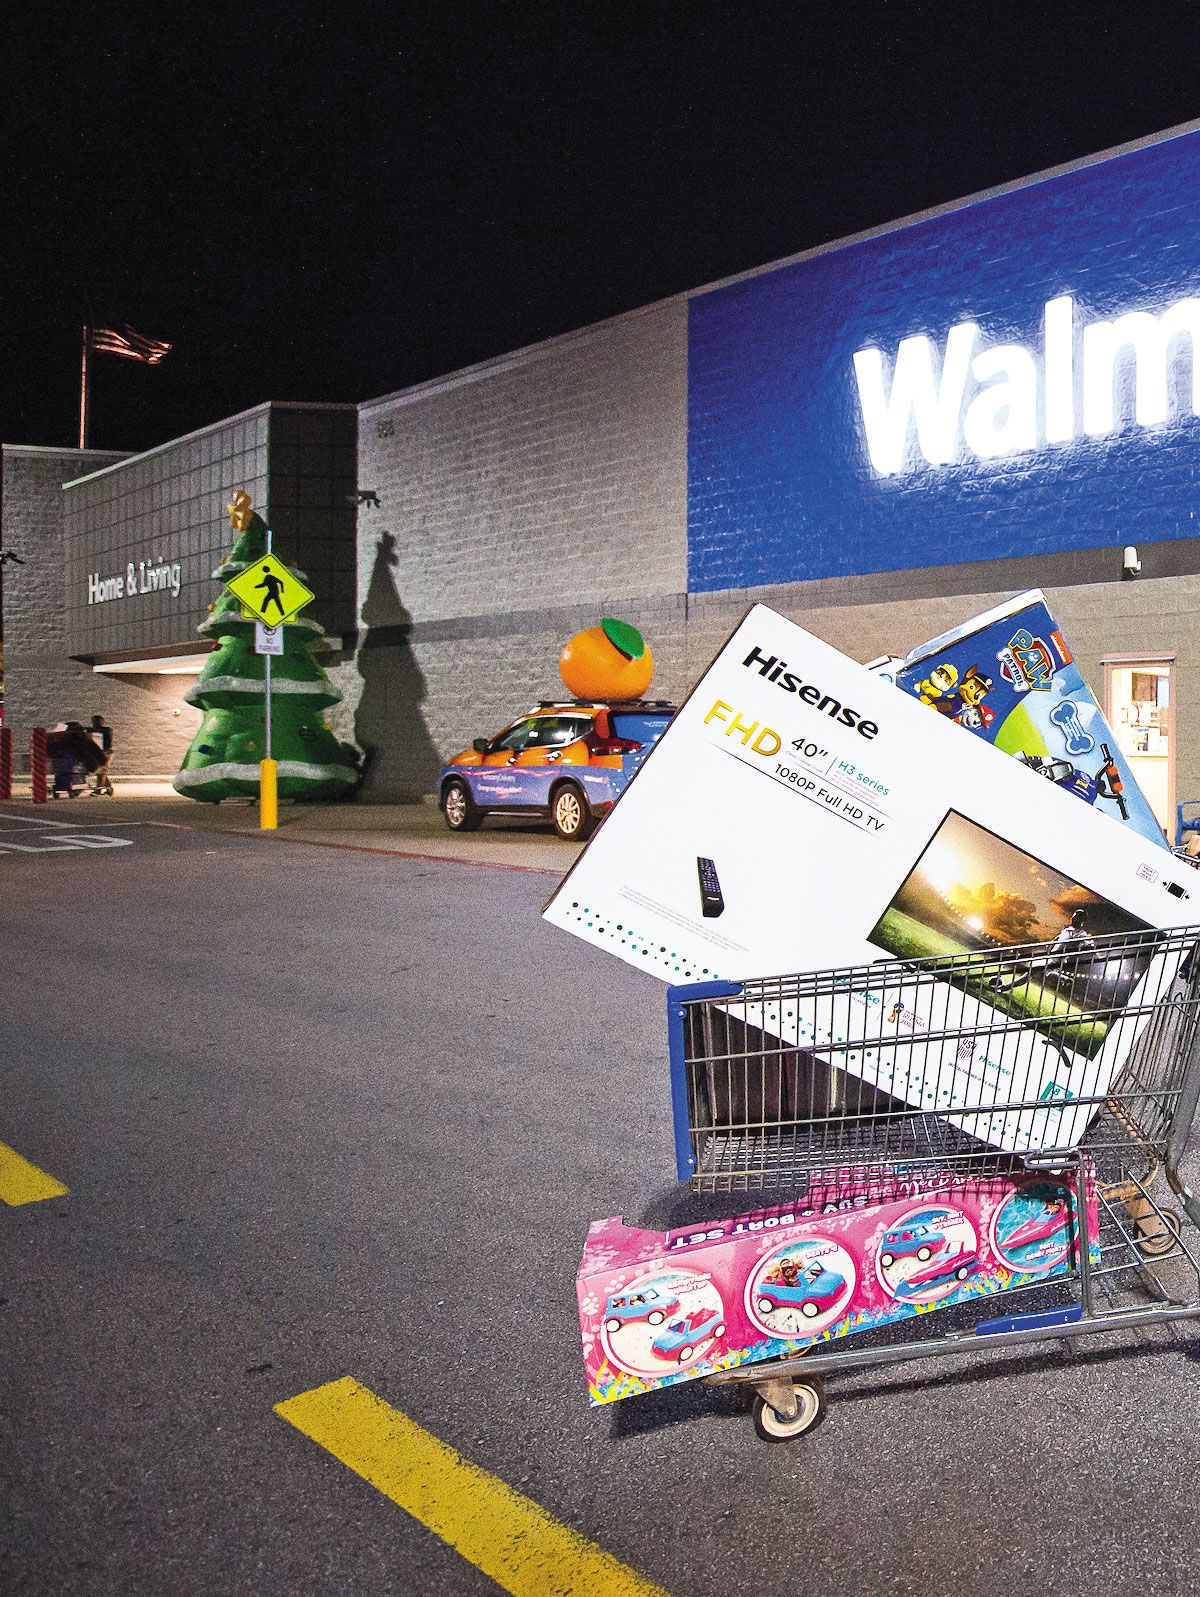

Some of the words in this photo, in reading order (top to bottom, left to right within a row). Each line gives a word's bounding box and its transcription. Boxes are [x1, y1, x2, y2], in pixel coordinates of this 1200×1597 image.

[88, 573, 124, 605] Home
[127, 562, 138, 597] &
[140, 556, 181, 598] Living
[1003, 653, 1024, 686] PATROL
[1008, 628, 1053, 692] PAW
[742, 646, 879, 740] Hisense
[703, 699, 782, 757] FHD
[774, 763, 816, 791] 1080P
[816, 788, 843, 809] Full
[842, 802, 863, 820] HD
[867, 815, 885, 831] TV
[837, 760, 857, 776] H3
[856, 773, 891, 796] series
[731, 1213, 796, 1236] BOAT
[822, 1194, 869, 1215] SUV
[670, 1228, 725, 1249] SET
